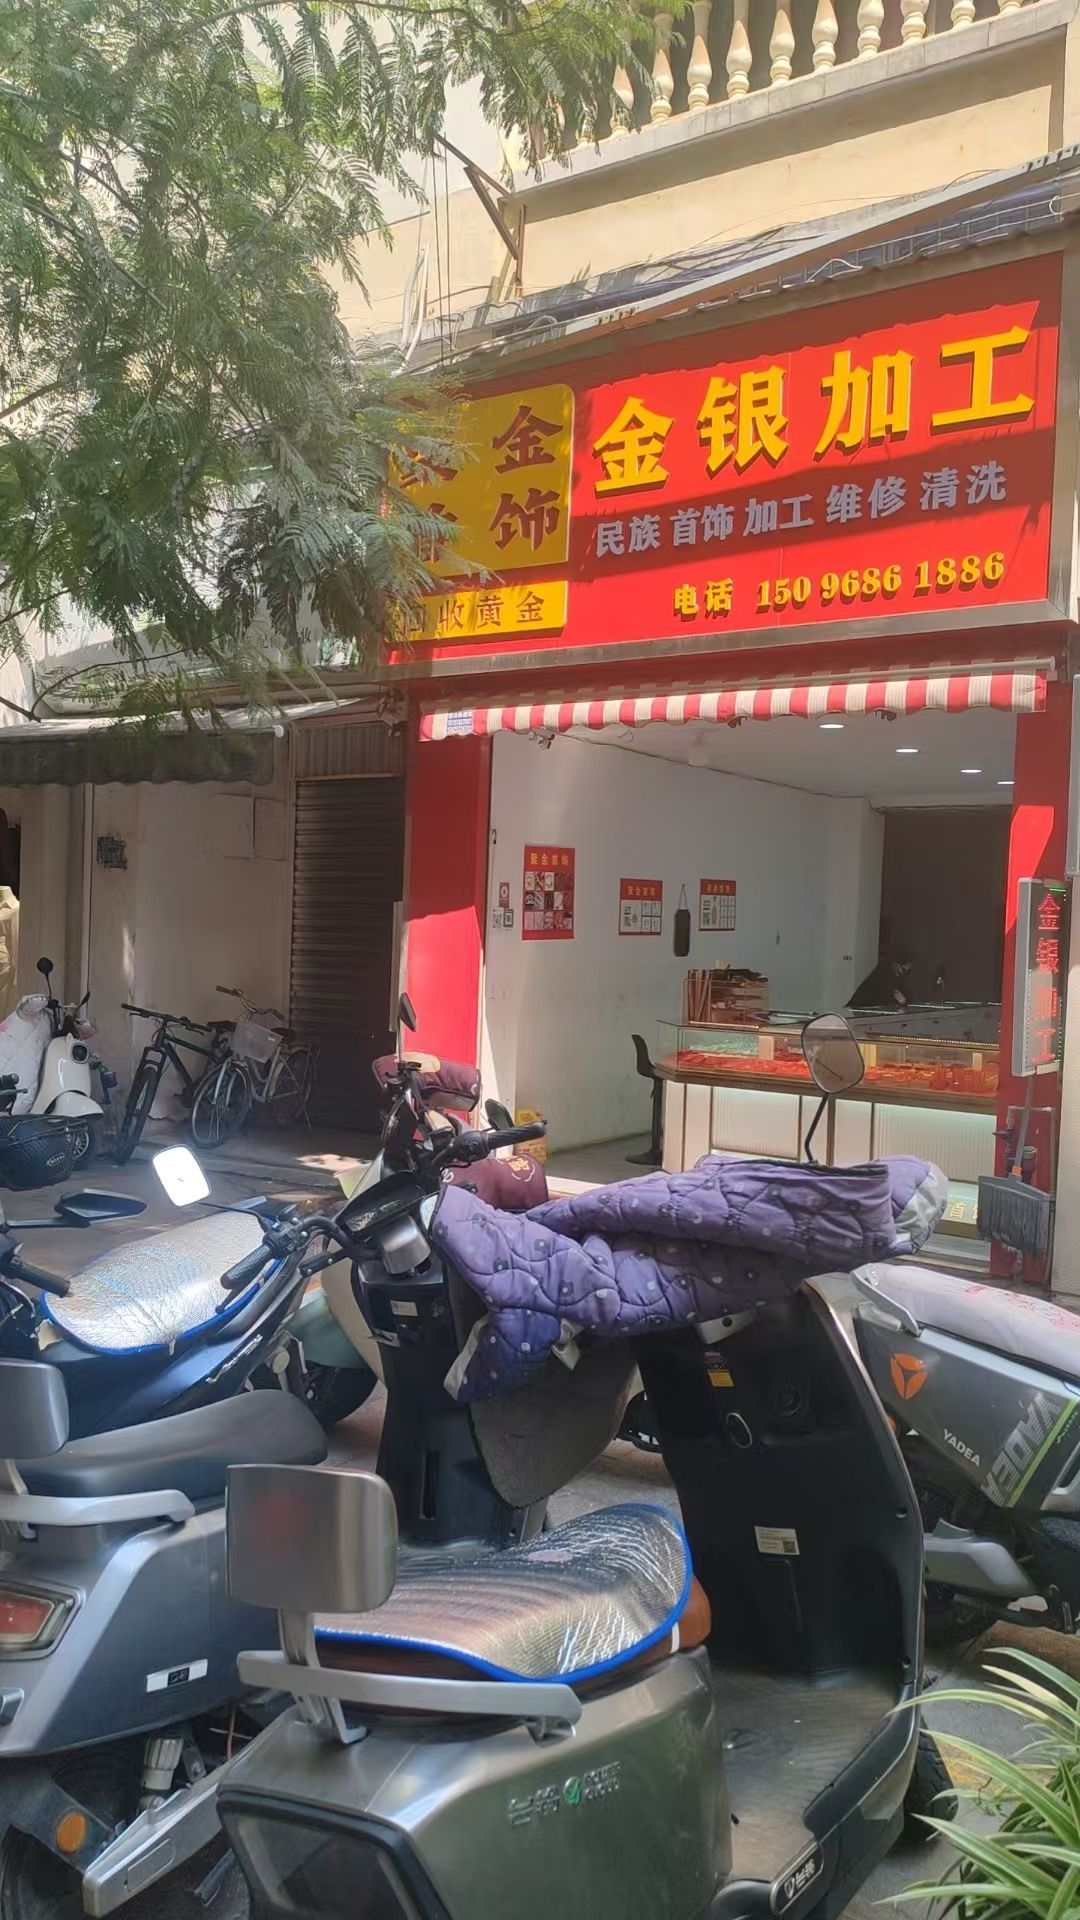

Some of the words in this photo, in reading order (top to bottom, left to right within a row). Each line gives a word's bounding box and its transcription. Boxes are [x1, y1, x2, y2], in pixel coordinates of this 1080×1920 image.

[592, 325, 1035, 499] 金银加工
[595, 515, 661, 557] 民族
[670, 504, 735, 546] 首饰
[743, 494, 815, 537] 加工
[826, 476, 907, 523] 维修
[919, 460, 1007, 511] 清洗
[674, 577, 734, 621] 电话
[757, 575, 812, 613] 150
[820, 564, 902, 607] 9686
[914, 551, 1005, 598] 1886
[943, 1428, 981, 1467] YADEA
